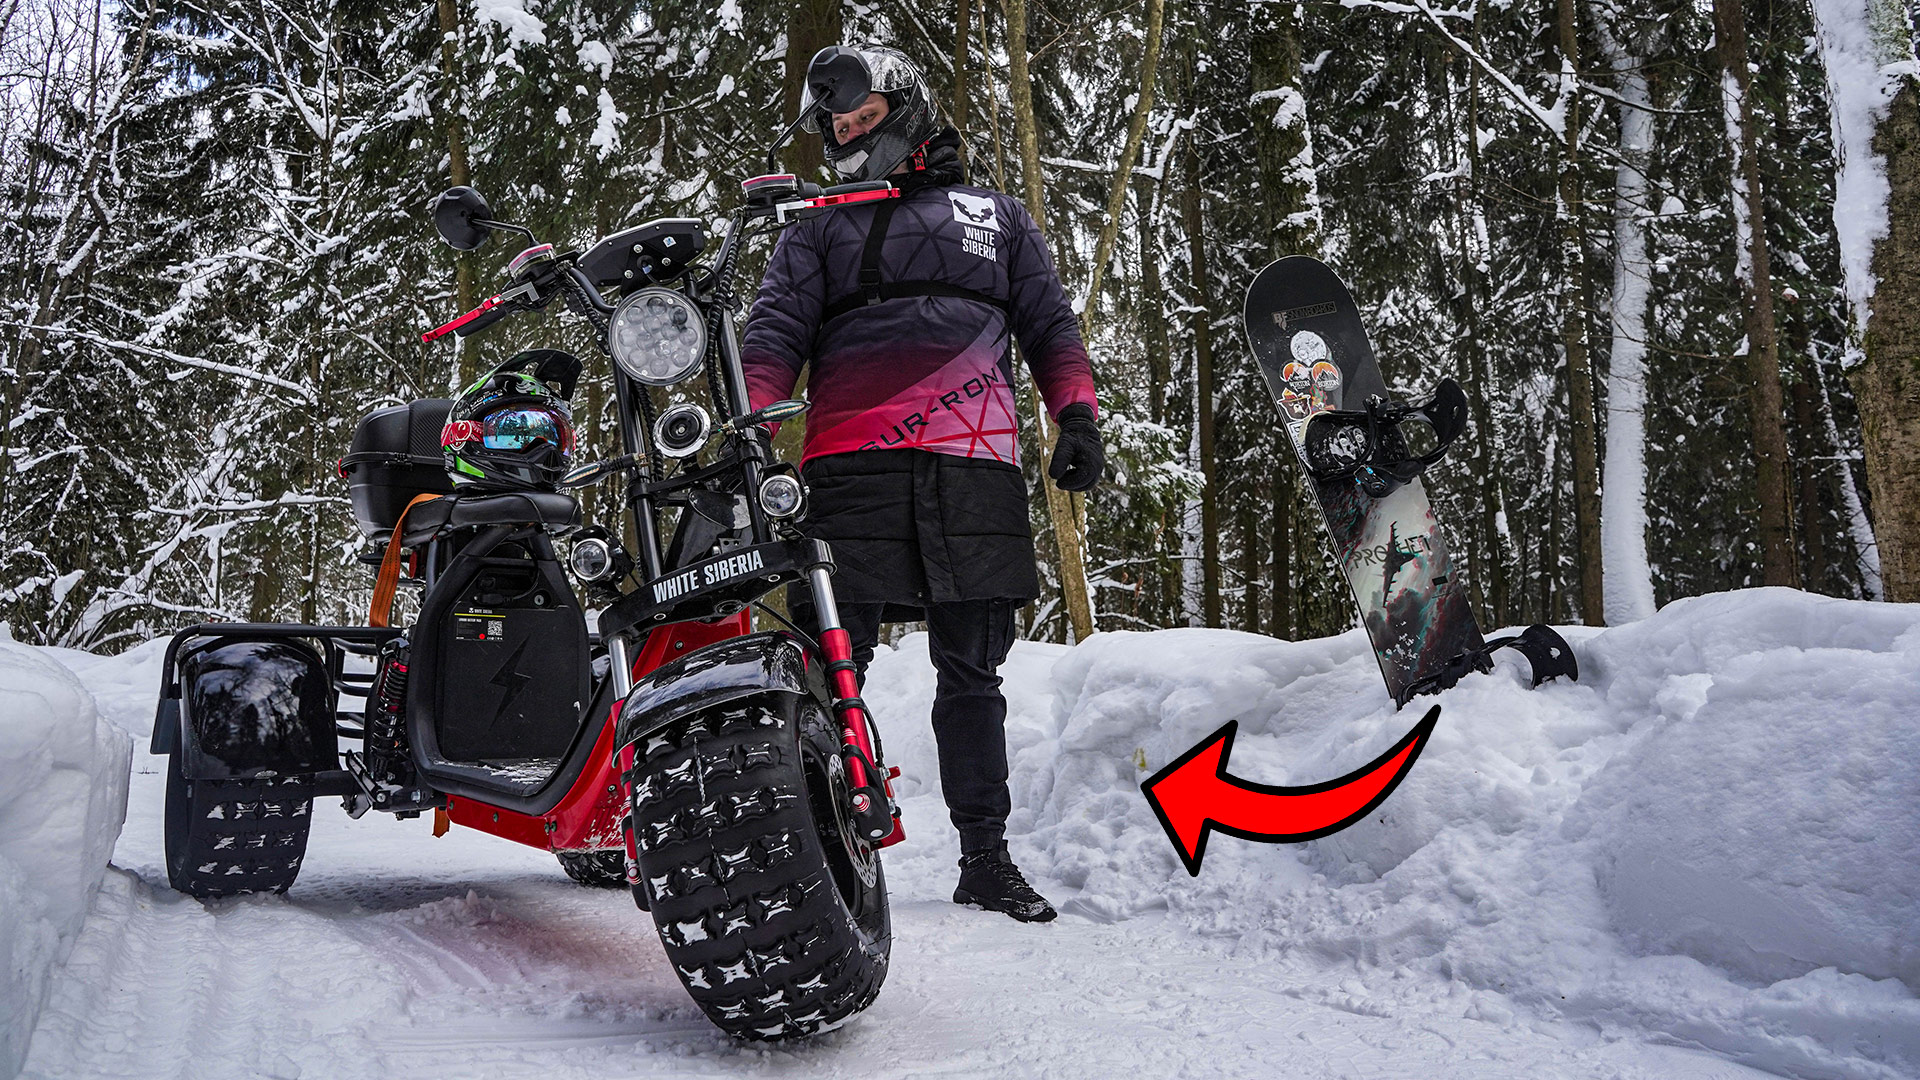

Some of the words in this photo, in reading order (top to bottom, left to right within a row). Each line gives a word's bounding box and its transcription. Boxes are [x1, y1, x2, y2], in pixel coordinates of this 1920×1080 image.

[962, 238, 997, 262] SIBERIA
[964, 225, 995, 246] WHITE
[1353, 535, 1431, 569] PROHET
[653, 569, 700, 604] WHITE
[704, 550, 764, 585] SIBERIA
